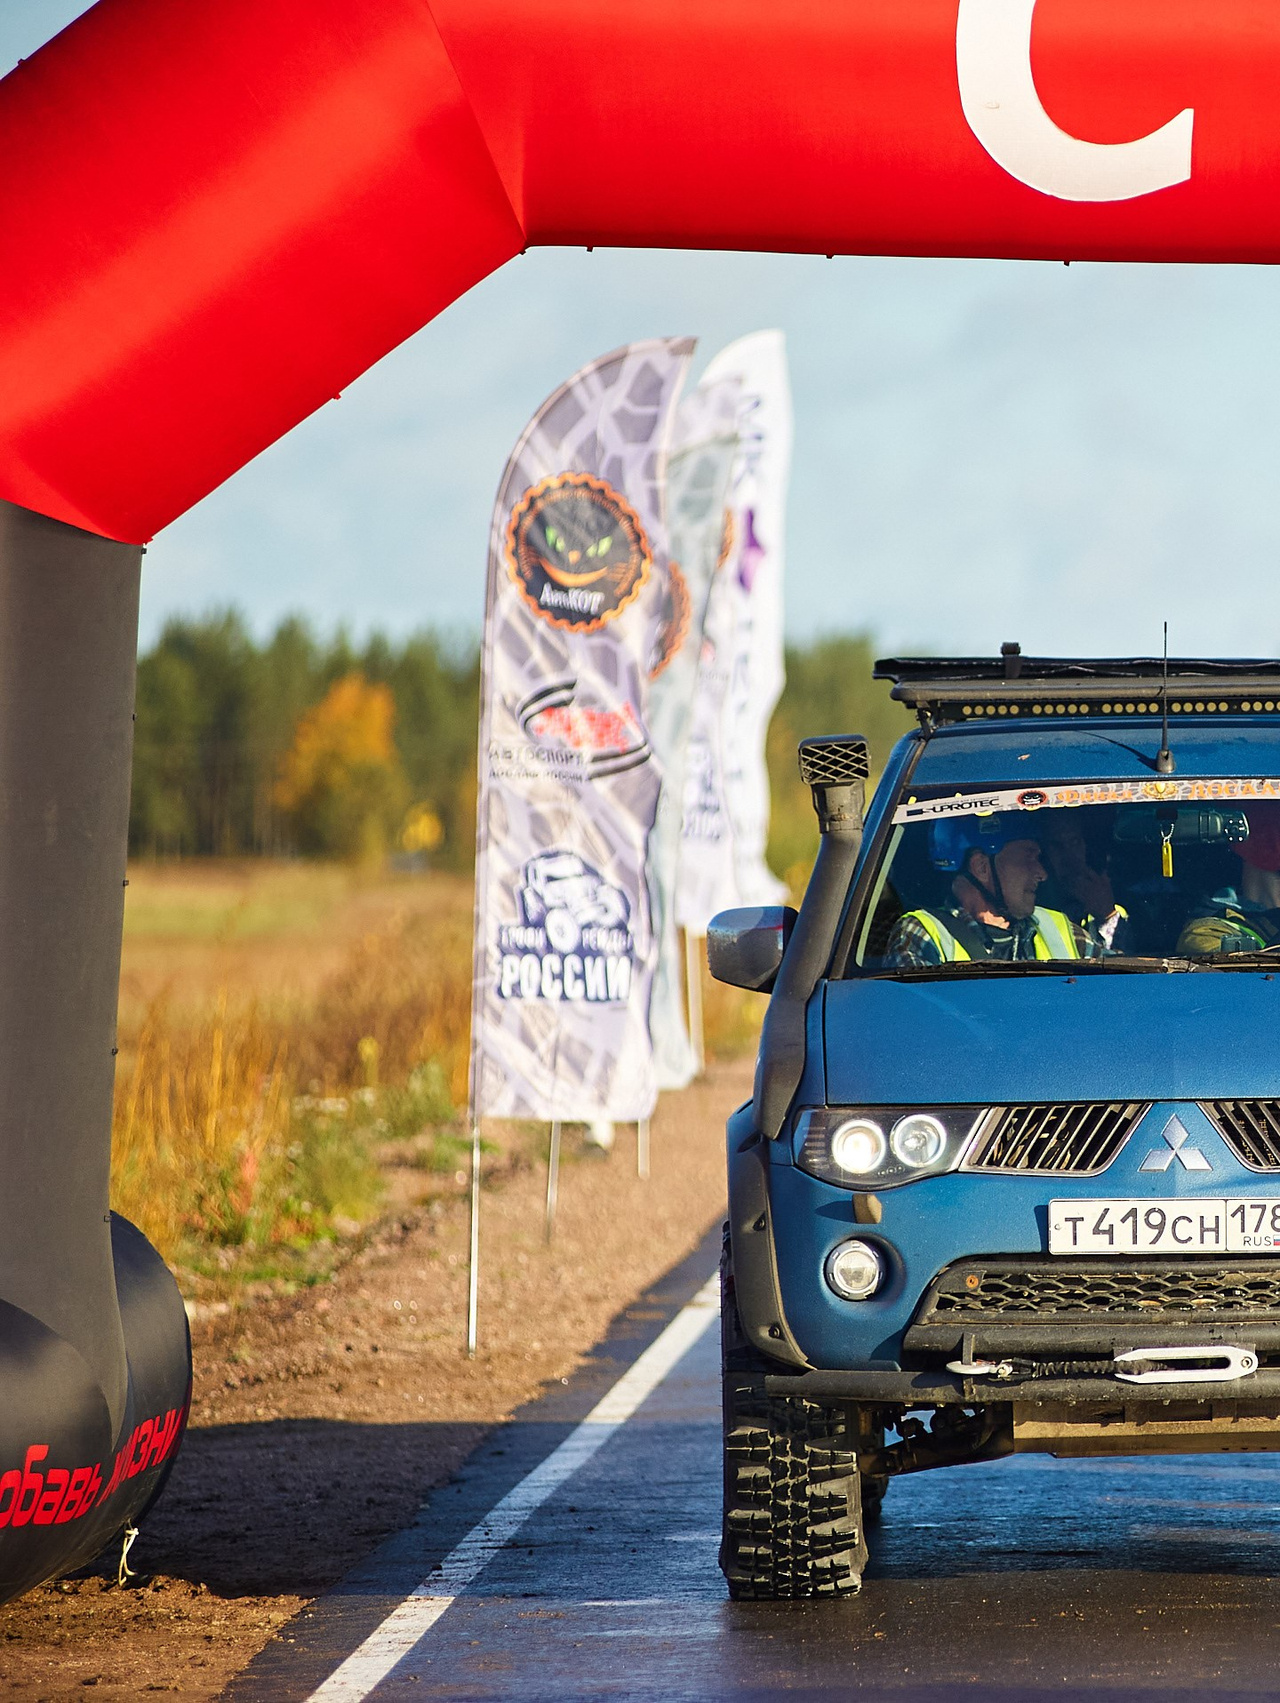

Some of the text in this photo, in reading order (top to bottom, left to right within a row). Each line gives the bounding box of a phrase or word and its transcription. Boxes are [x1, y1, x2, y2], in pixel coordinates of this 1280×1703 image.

[920, 798, 999, 814] SUPROTEC
[500, 953, 632, 1001] РОССИИ
[1243, 1235, 1272, 1247] RUS
